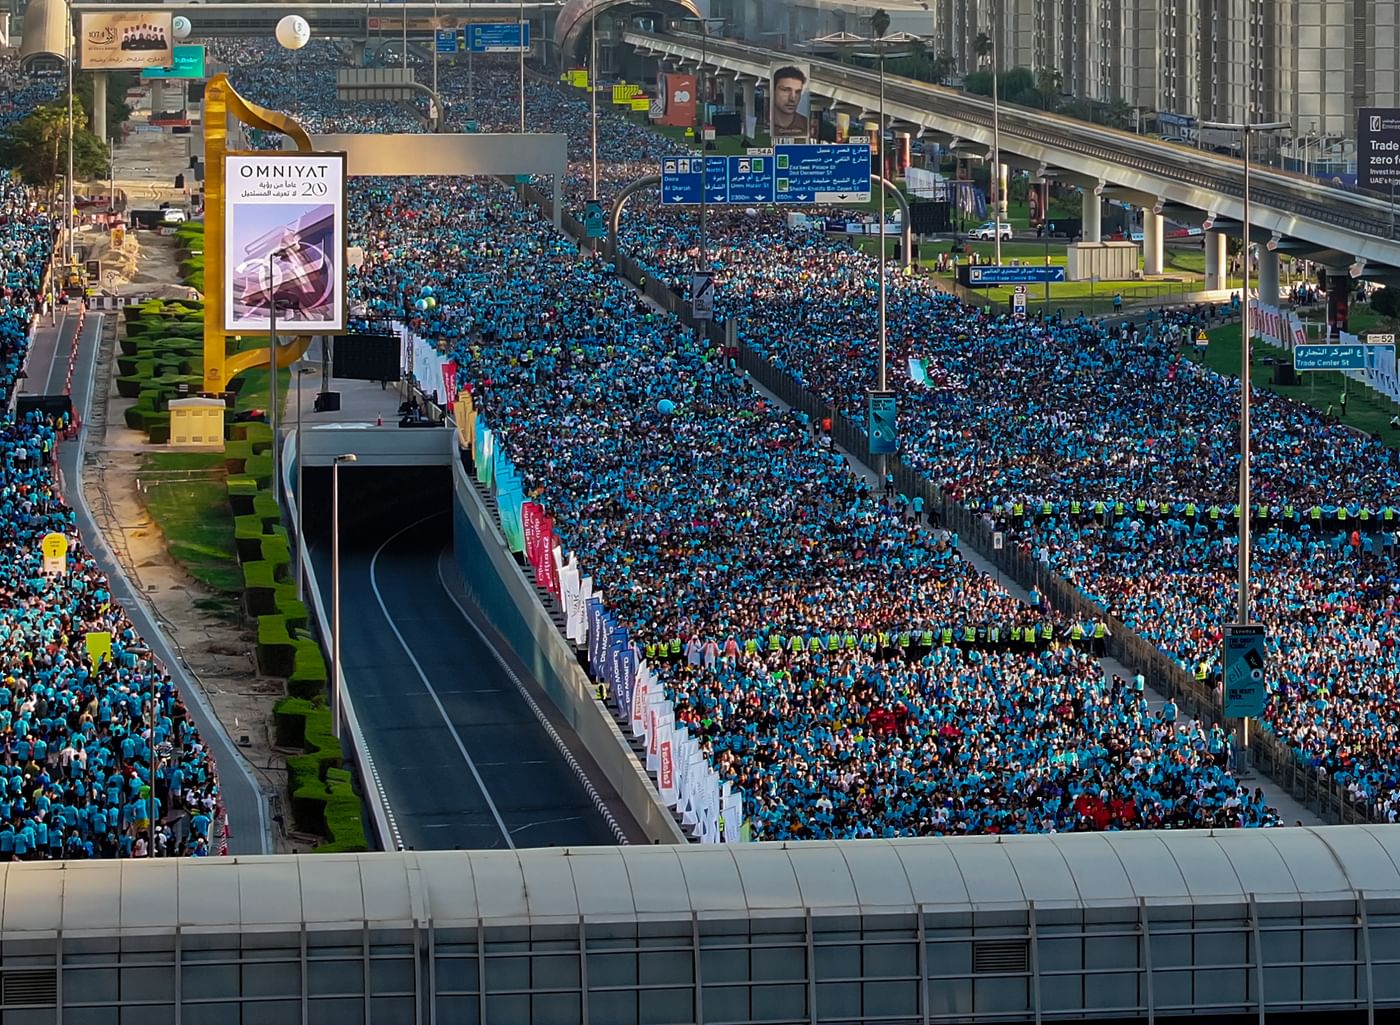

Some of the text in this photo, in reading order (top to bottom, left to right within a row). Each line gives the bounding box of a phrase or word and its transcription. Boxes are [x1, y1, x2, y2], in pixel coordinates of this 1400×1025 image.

[1370, 140, 1399, 150] Trade
[1370, 156, 1392, 164] zero
[241, 165, 328, 177] OMNIYAT
[302, 182, 327, 196] 20
